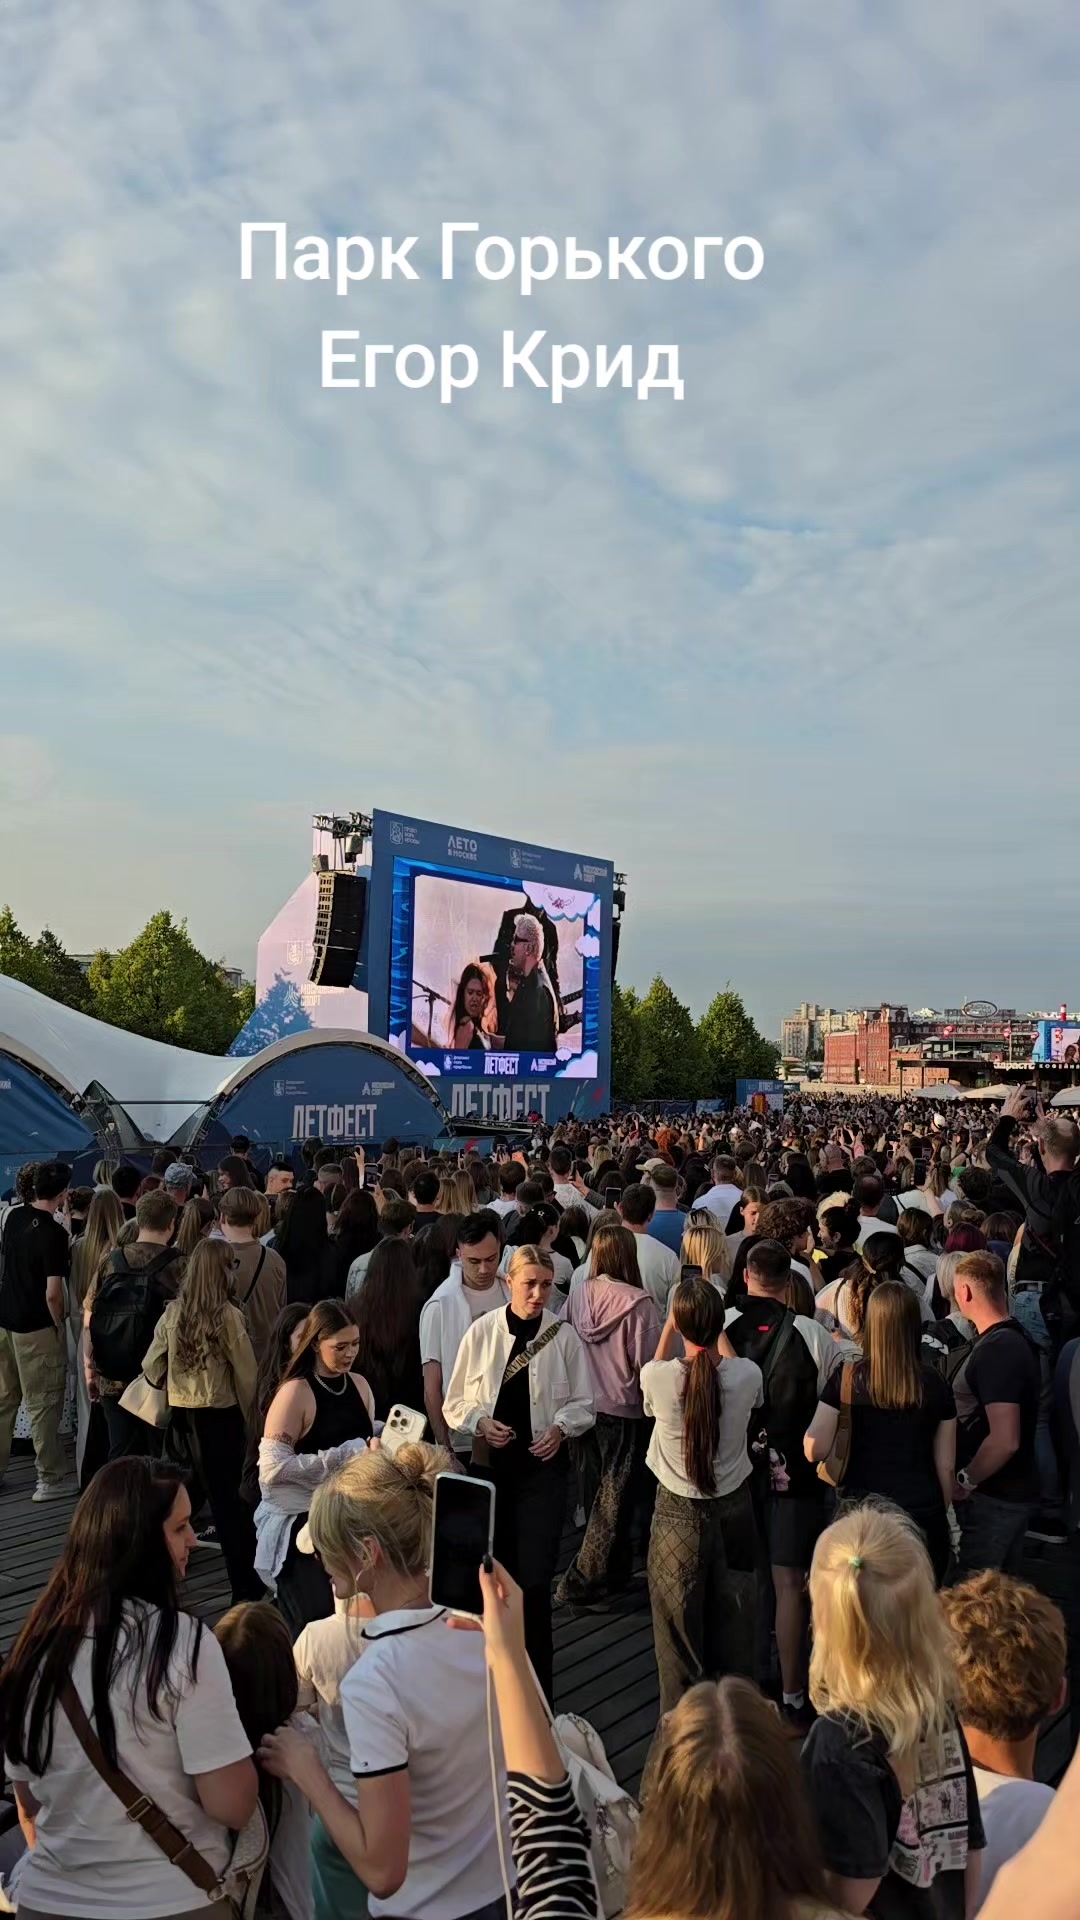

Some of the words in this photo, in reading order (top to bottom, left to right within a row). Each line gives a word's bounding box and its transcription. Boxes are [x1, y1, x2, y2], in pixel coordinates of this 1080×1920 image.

[447, 835, 478, 853] ЛЕТО
[484, 1056, 519, 1075] ЛЕТФЕСТ
[451, 1084, 551, 1124] ЛЕТФЕСТ
[291, 1104, 378, 1141] ЛЕТФЕСТ
